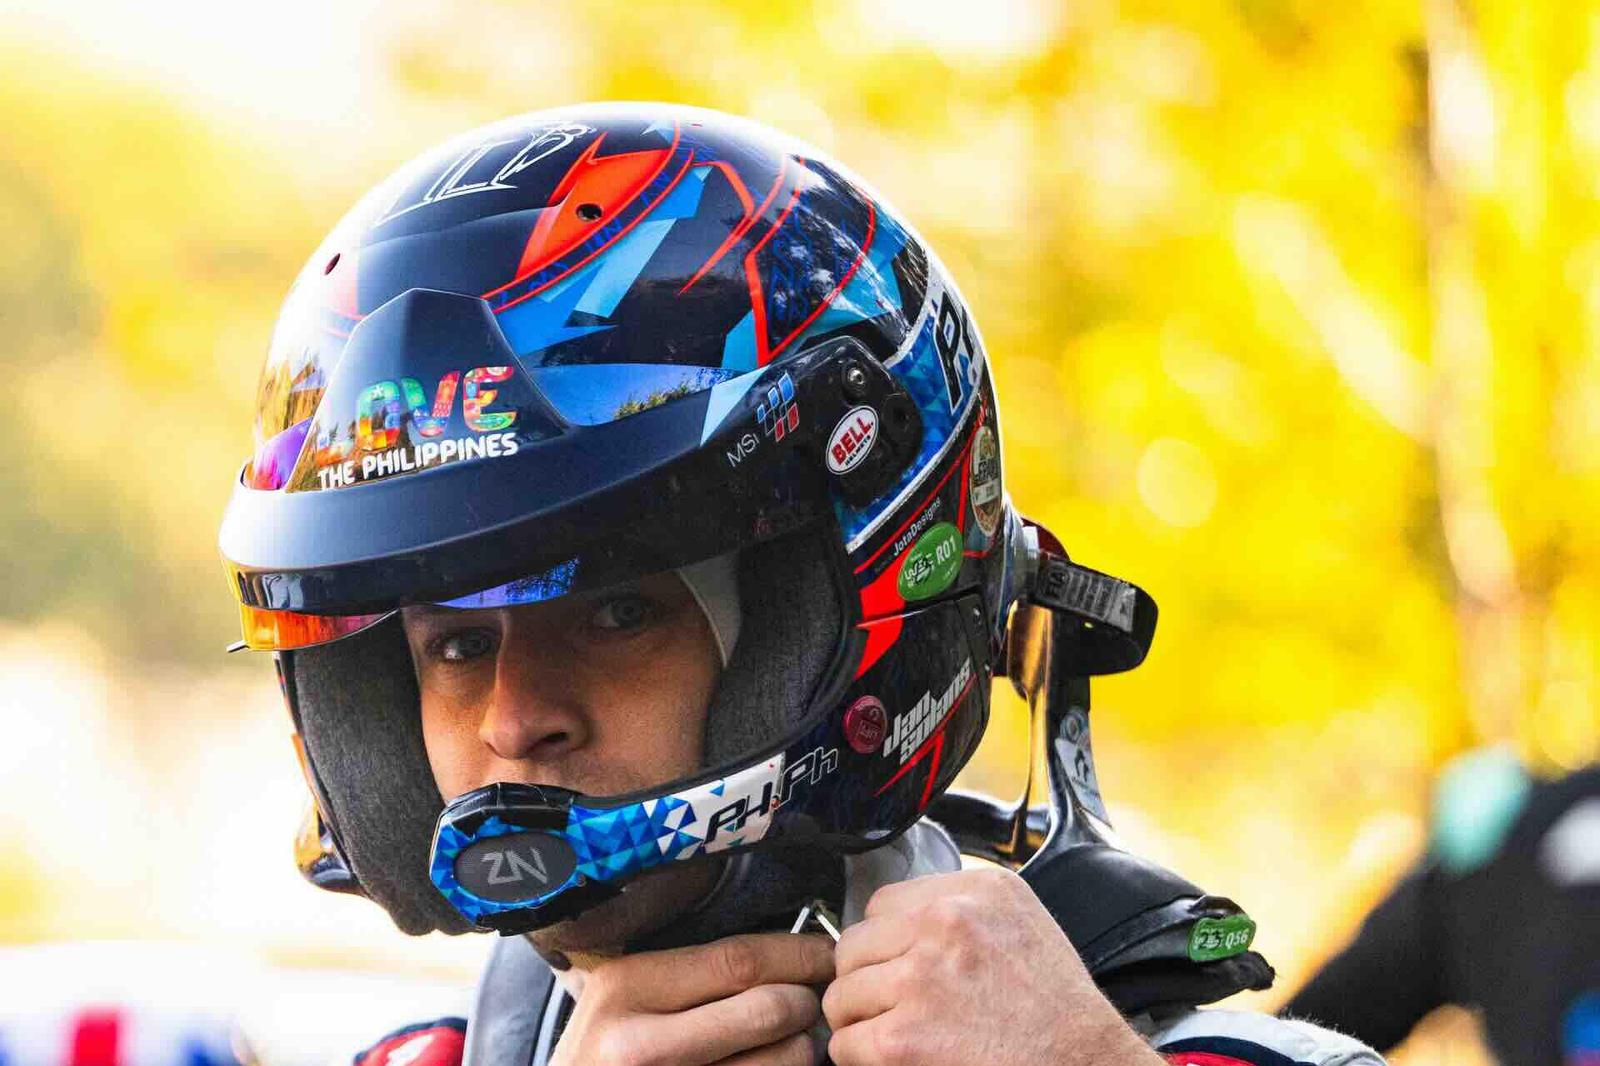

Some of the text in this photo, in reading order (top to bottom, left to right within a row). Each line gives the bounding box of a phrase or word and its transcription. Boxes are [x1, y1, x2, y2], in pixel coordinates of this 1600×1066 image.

[317, 432, 519, 490] THE PHILIPPINES
[893, 496, 943, 556] JotaDesigns
[482, 848, 548, 886] ZN
